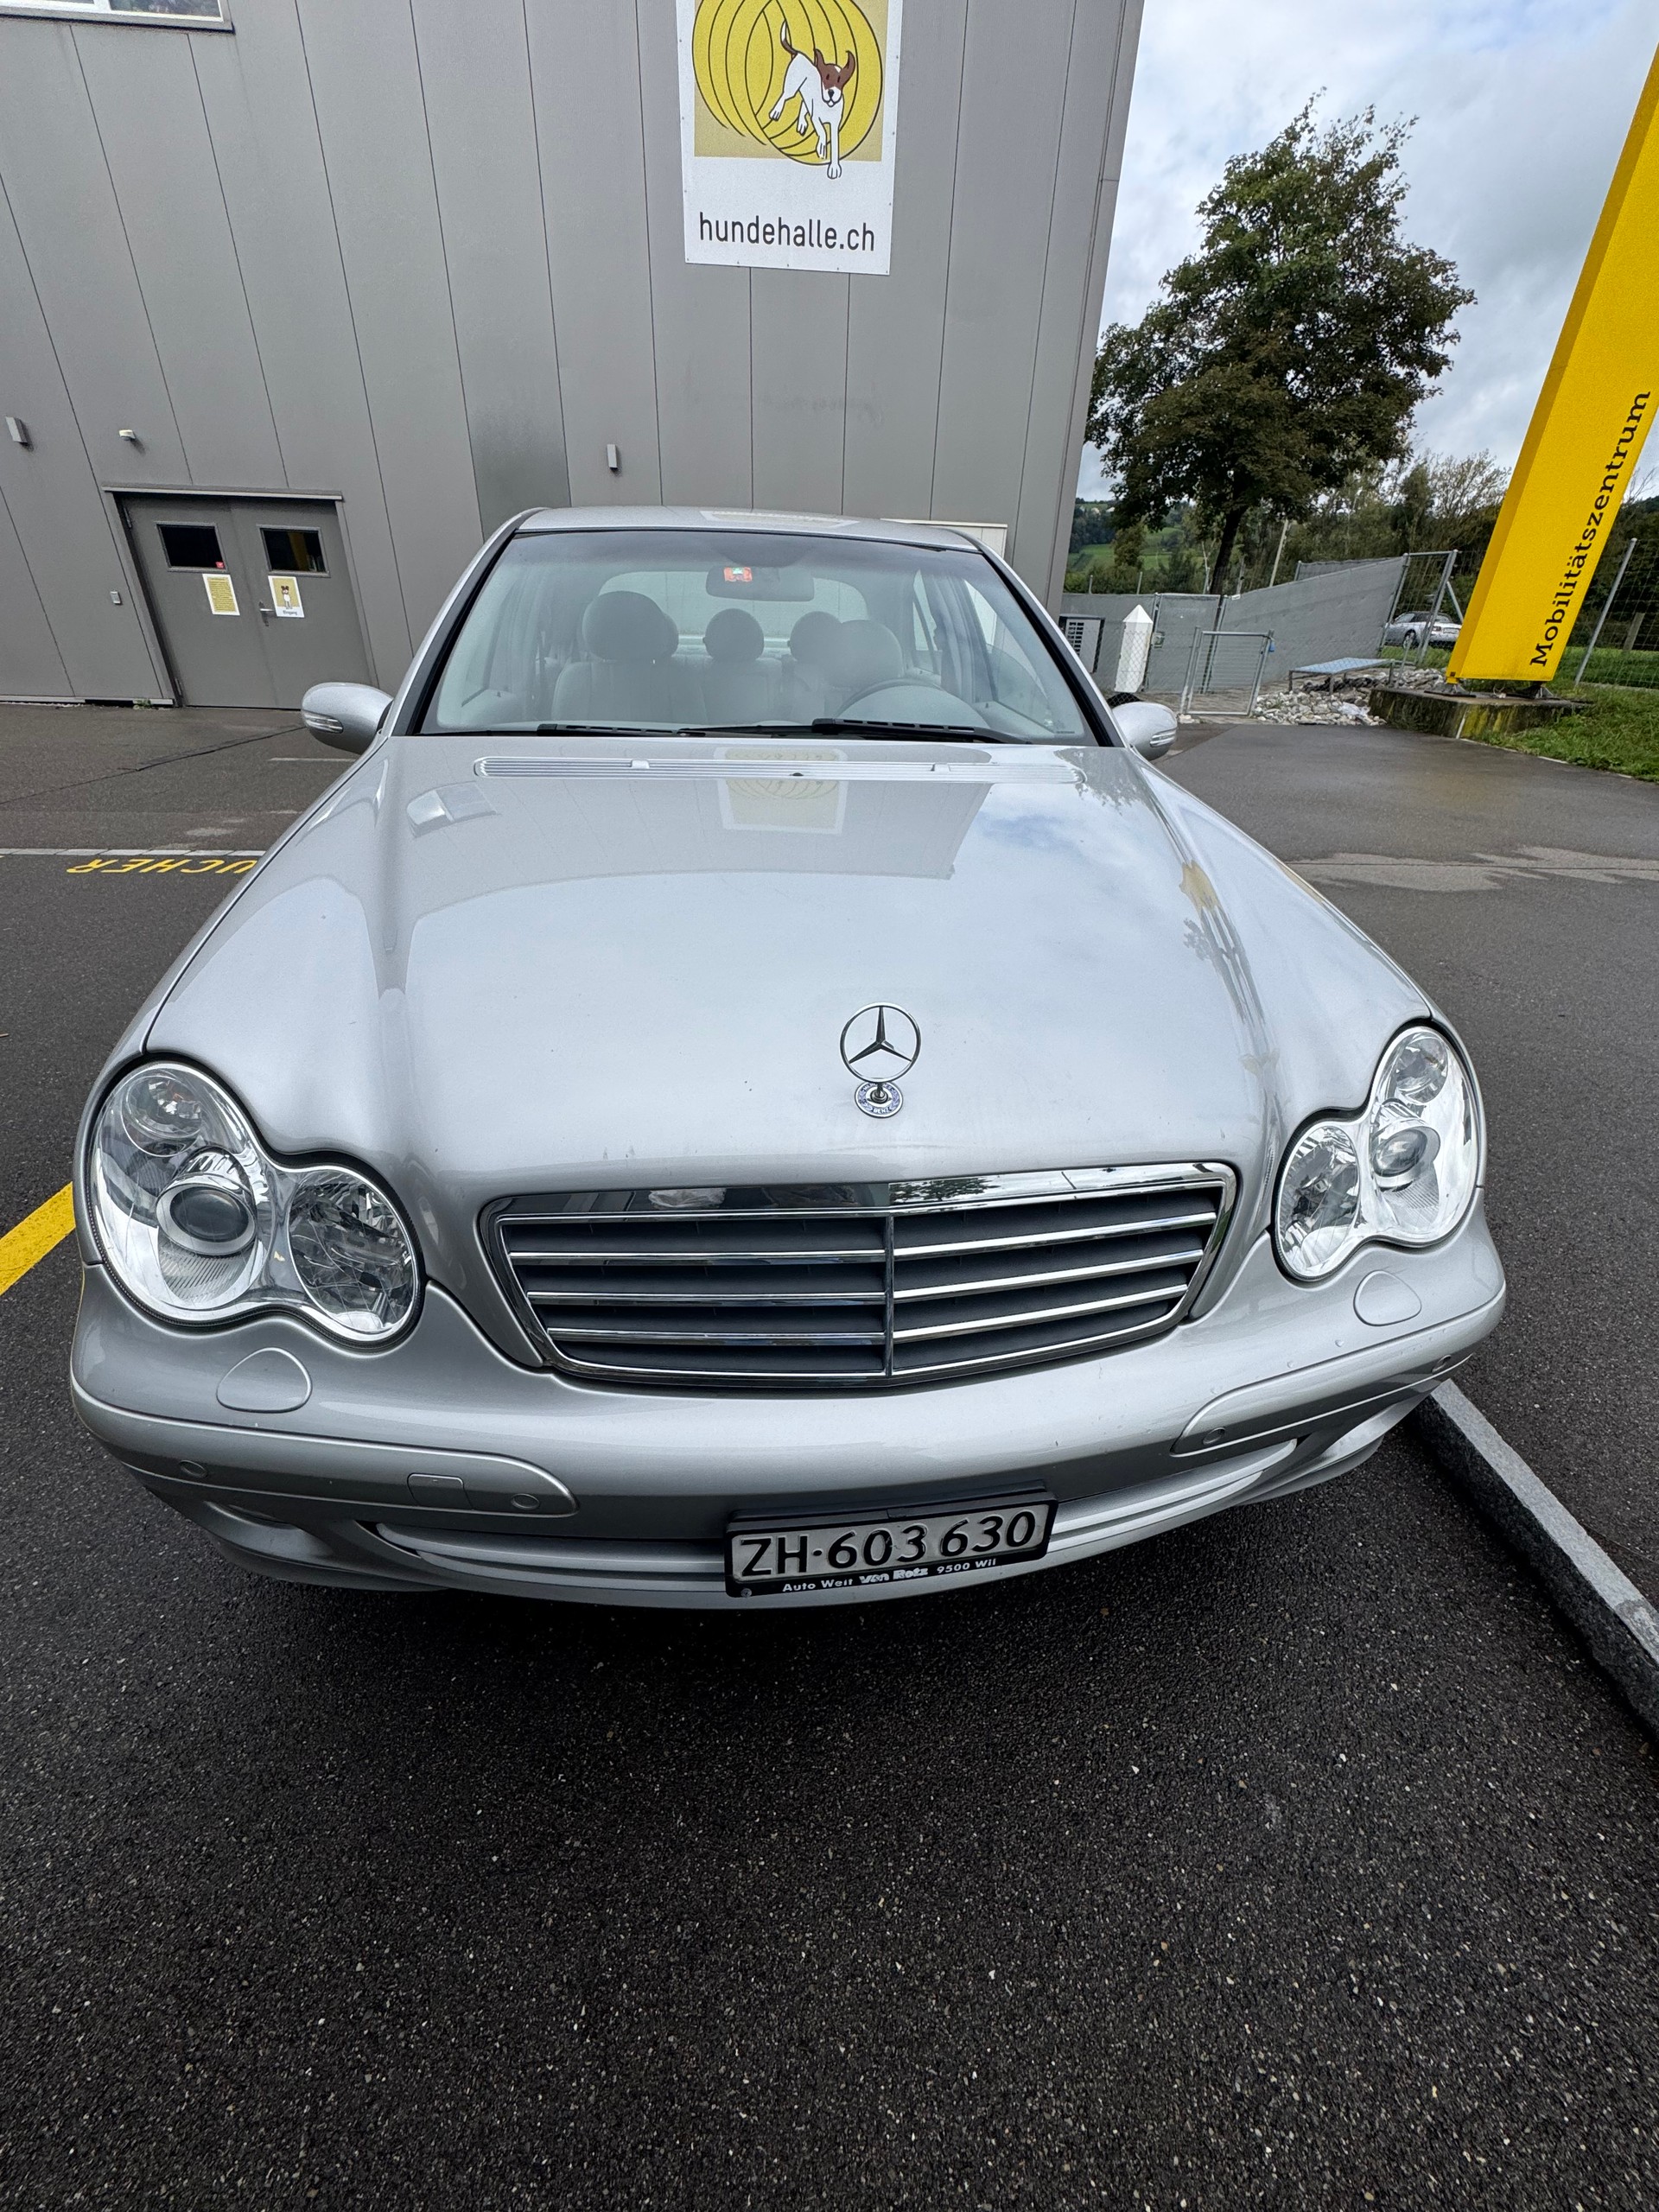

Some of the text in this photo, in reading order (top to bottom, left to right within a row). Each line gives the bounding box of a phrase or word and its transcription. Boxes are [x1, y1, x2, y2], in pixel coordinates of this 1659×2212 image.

[700, 212, 874, 251] hundehalle.ch
[1529, 391, 1651, 667] Mobilitätszentrum
[782, 1583, 816, 1592] Auto
[893, 1567, 929, 1580] Rotz
[937, 1562, 970, 1574] 9500
[975, 1558, 996, 1568] Wil
